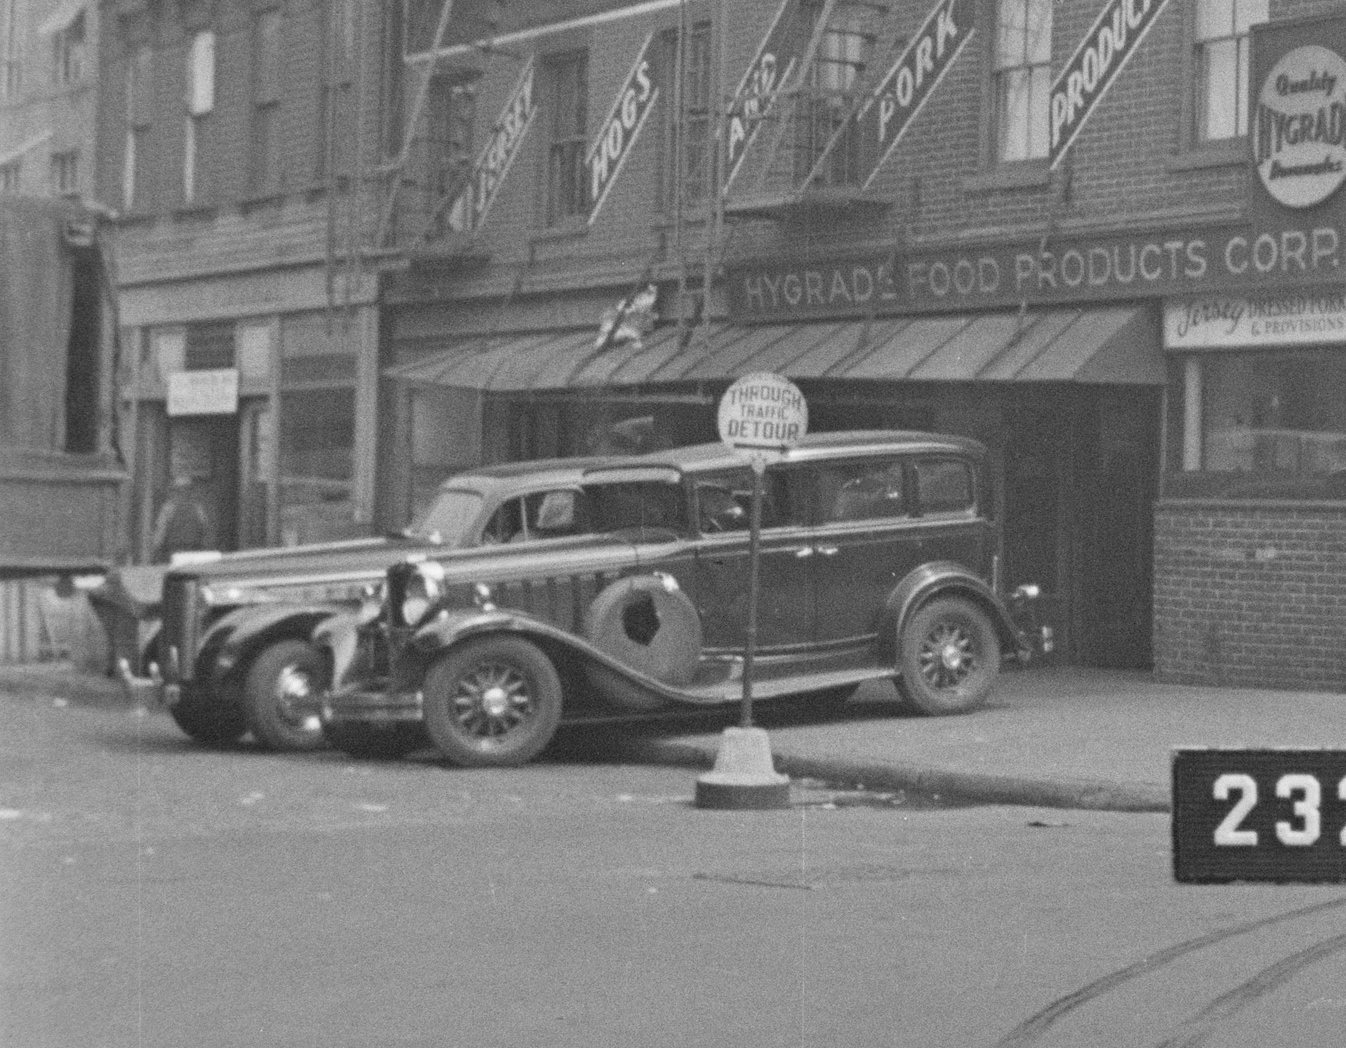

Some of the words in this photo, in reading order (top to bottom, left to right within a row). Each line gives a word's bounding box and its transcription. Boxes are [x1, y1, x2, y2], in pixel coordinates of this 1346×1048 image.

[592, 60, 651, 201] HOGS
[907, 256, 1000, 297] FOOD
[1015, 240, 1208, 290] PRODUCTS
[1225, 228, 1340, 274] CORP.
[1177, 298, 1246, 337] Jersey
[1264, 317, 1345, 334] PROVISIONS
[730, 385, 801, 411] THROUGH
[741, 404, 789, 420] TRAFFIC
[727, 418, 799, 441] DETOUR
